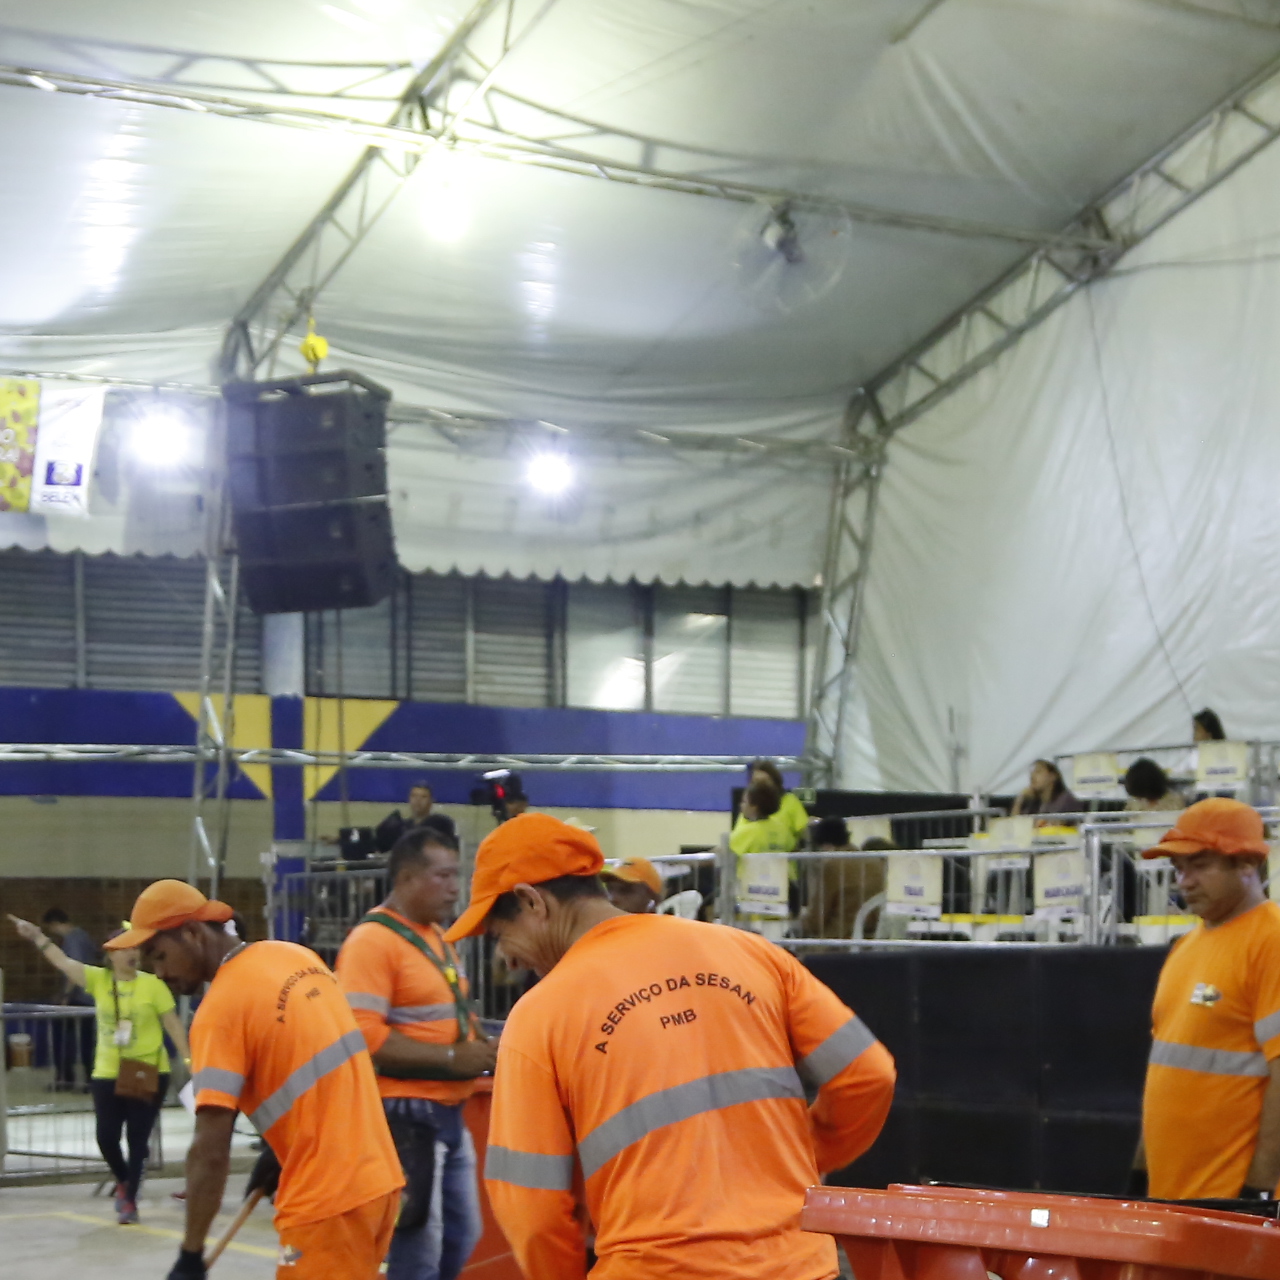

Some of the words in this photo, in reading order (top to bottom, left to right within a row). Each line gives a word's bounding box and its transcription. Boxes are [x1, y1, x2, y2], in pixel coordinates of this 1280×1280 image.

[665, 975, 691, 992] DA
[695, 972, 757, 1006] SESAN
[601, 983, 662, 1036] SERVIÇO
[659, 1008, 697, 1029] PMB
[595, 1041, 608, 1054] A
